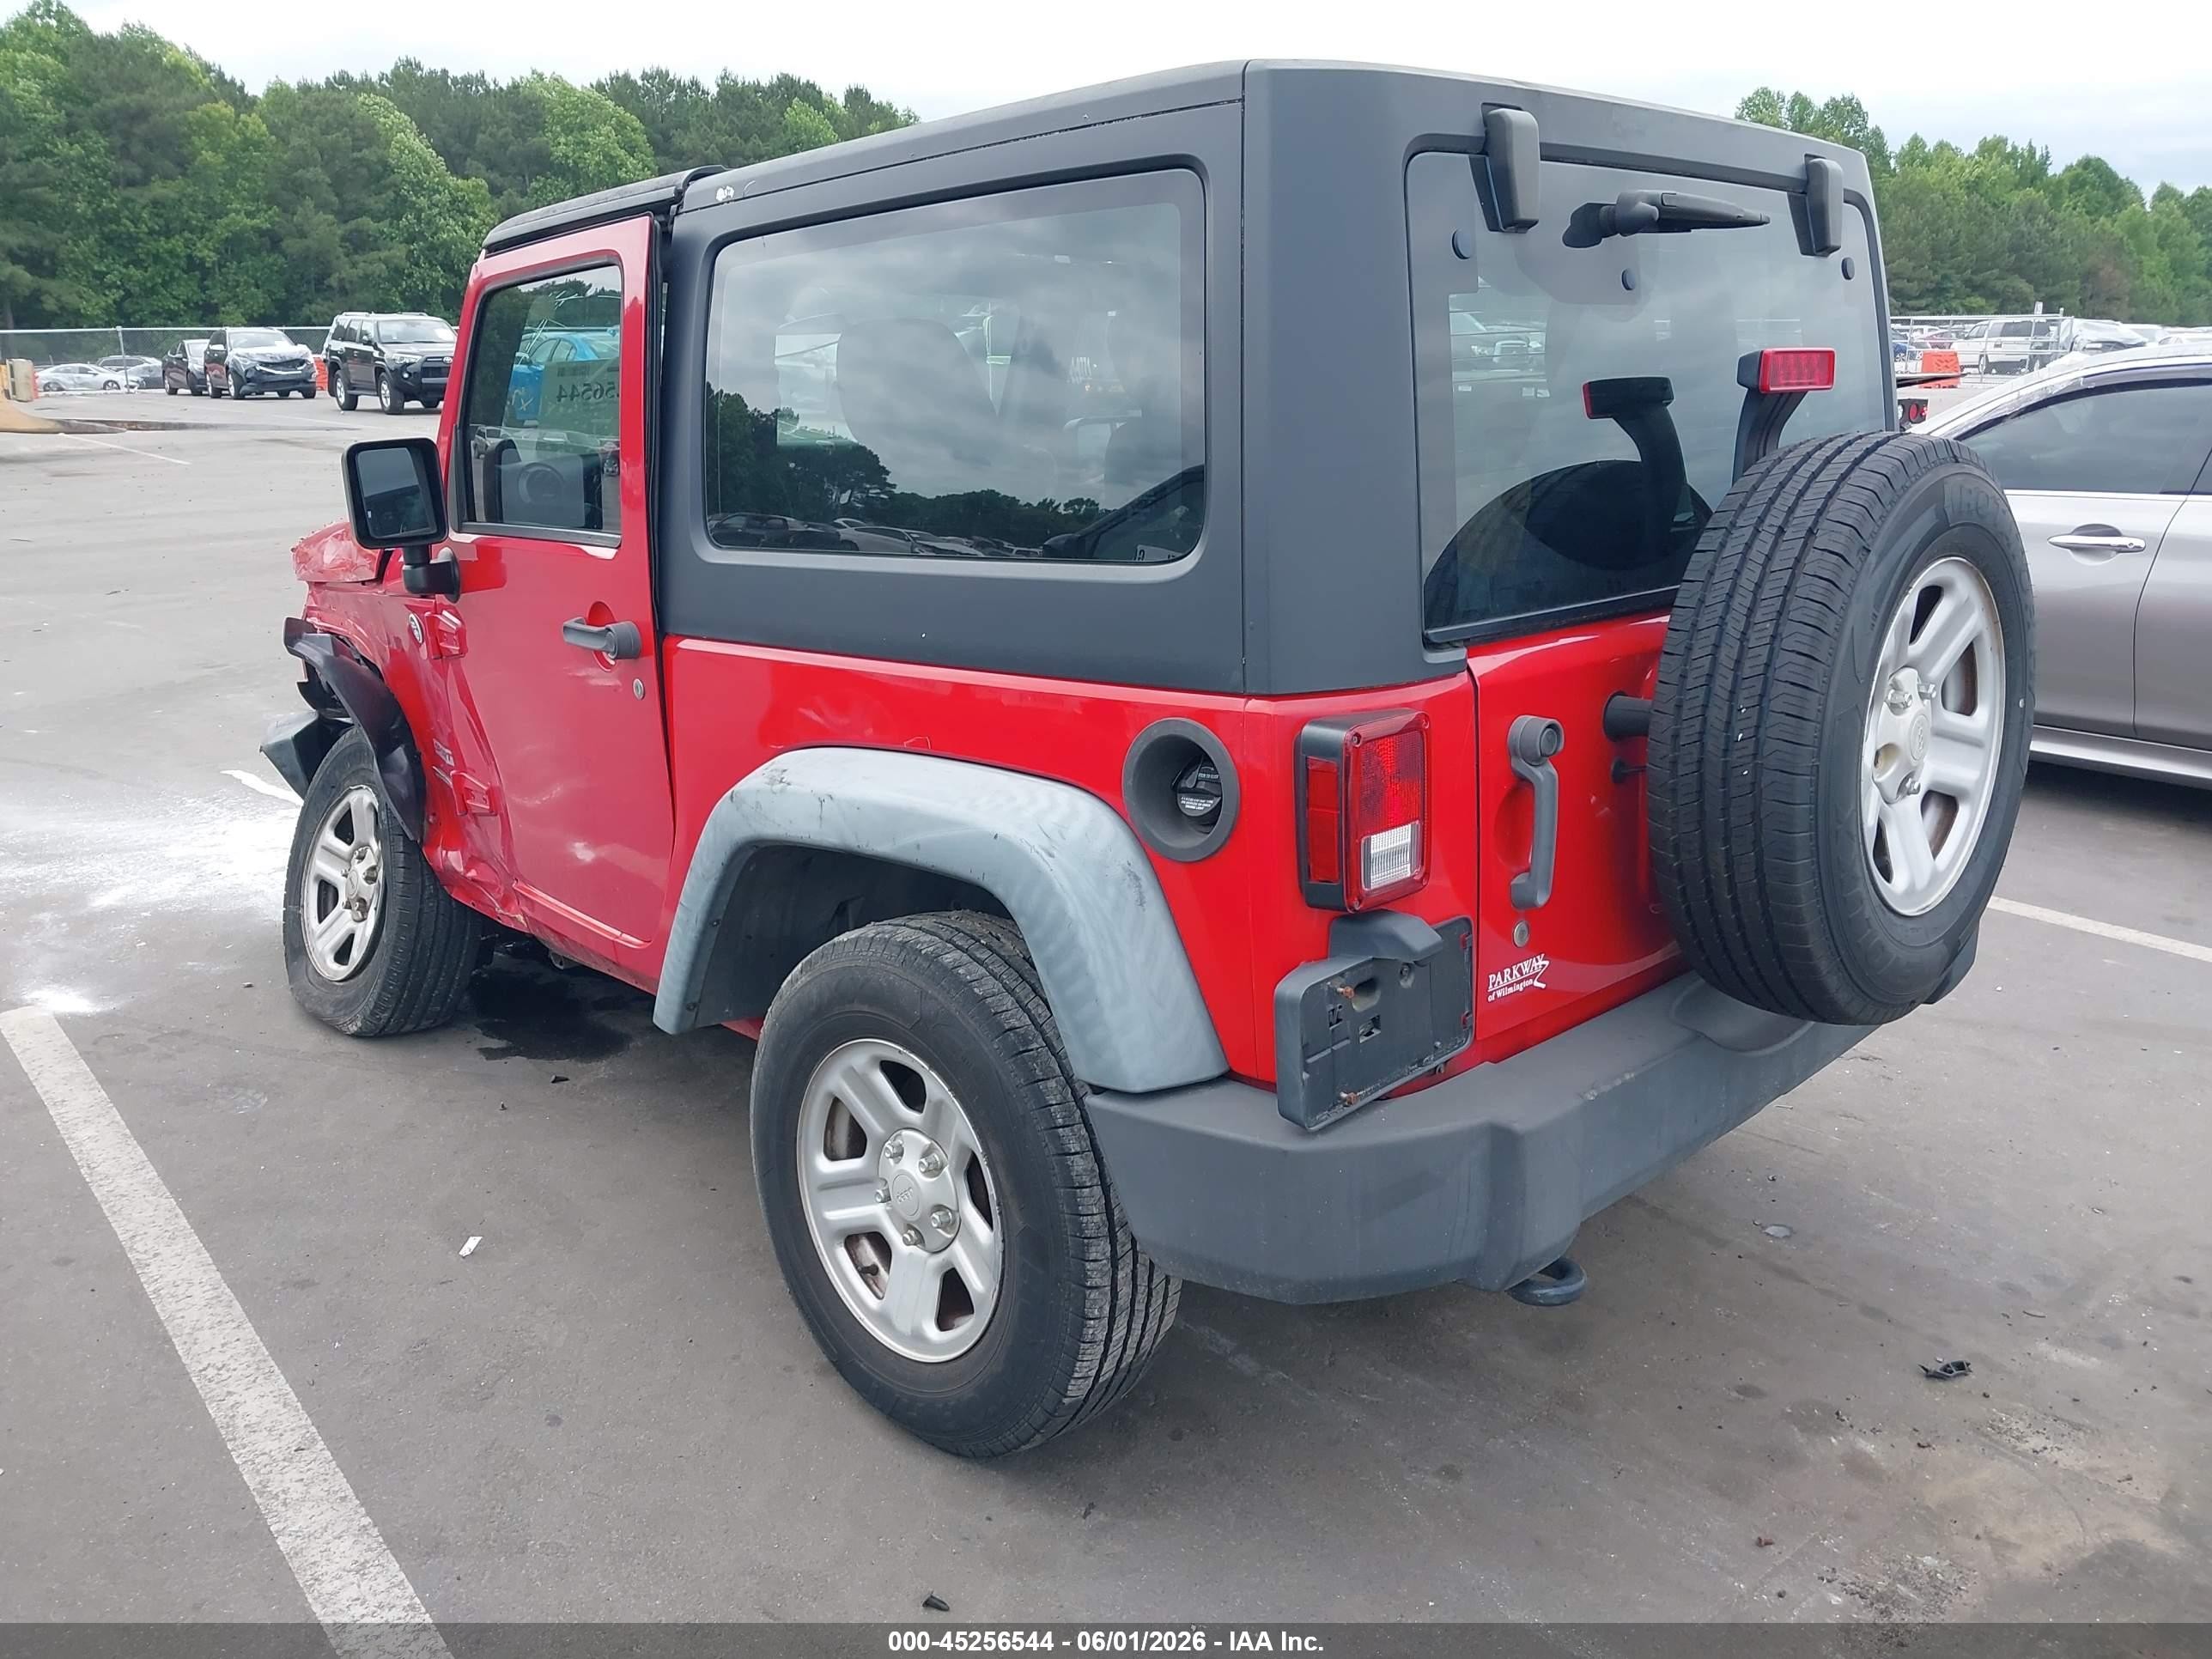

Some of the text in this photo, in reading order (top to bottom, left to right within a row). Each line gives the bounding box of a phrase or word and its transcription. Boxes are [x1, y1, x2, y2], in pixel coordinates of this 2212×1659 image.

[1488, 953, 1547, 989] PARKWAY
[1487, 979, 1534, 1002] of Wilmington
